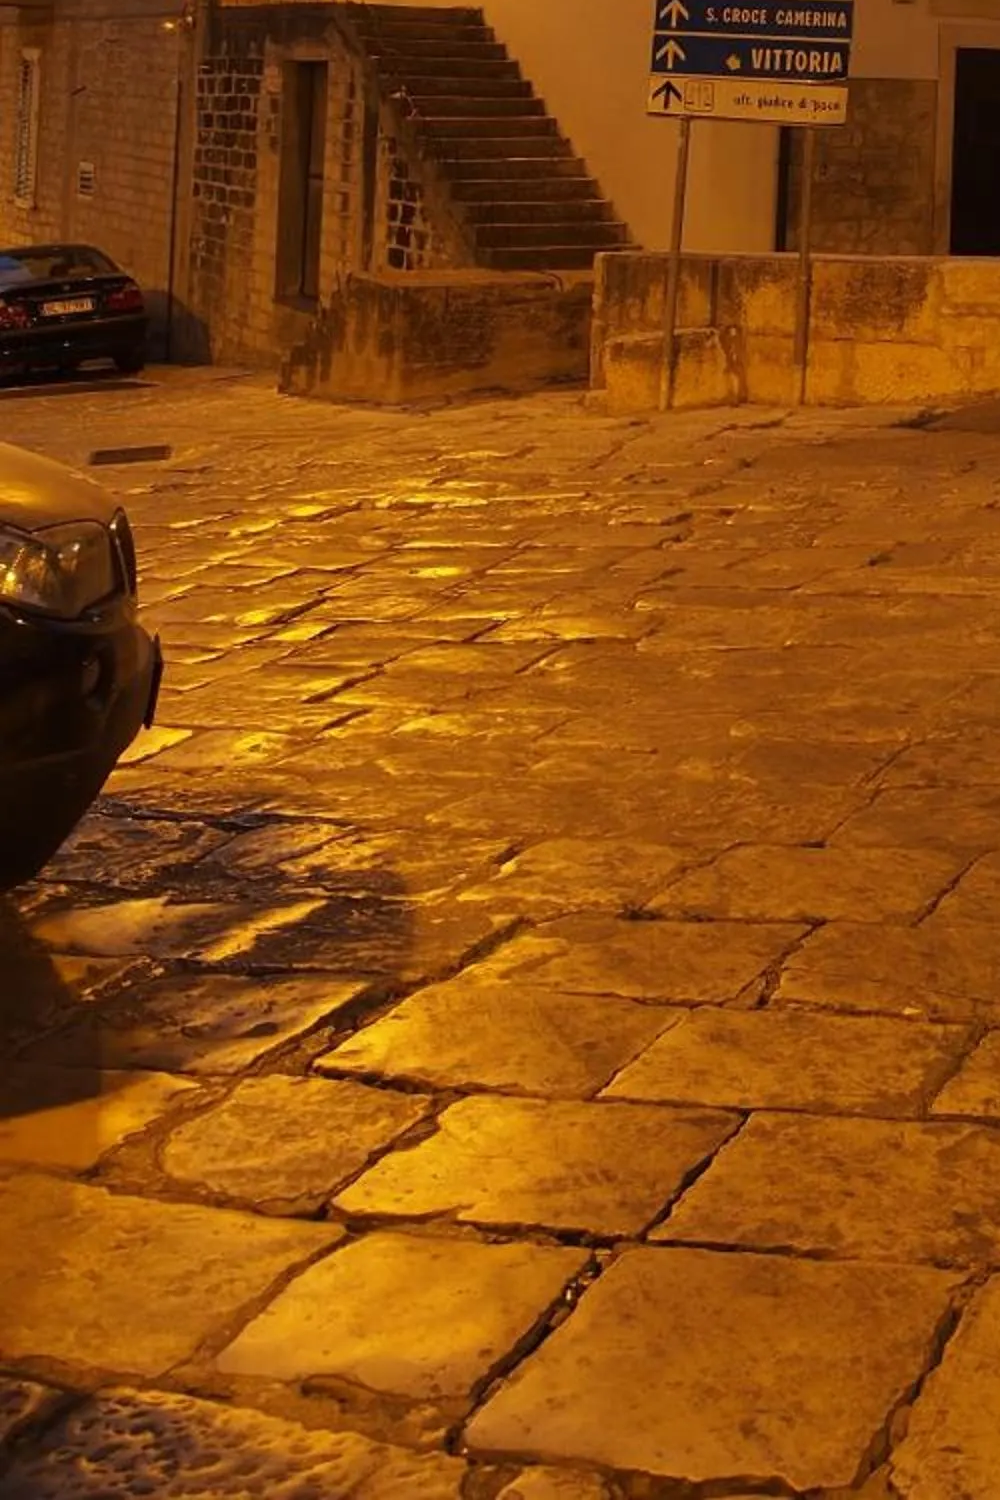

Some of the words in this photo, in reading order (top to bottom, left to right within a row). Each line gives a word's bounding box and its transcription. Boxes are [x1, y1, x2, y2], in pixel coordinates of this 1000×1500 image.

[706, 7, 719, 22] S.
[723, 8, 767, 25] CROCE
[775, 10, 847, 28] CAMERINA
[751, 48, 843, 73] VITTORIA
